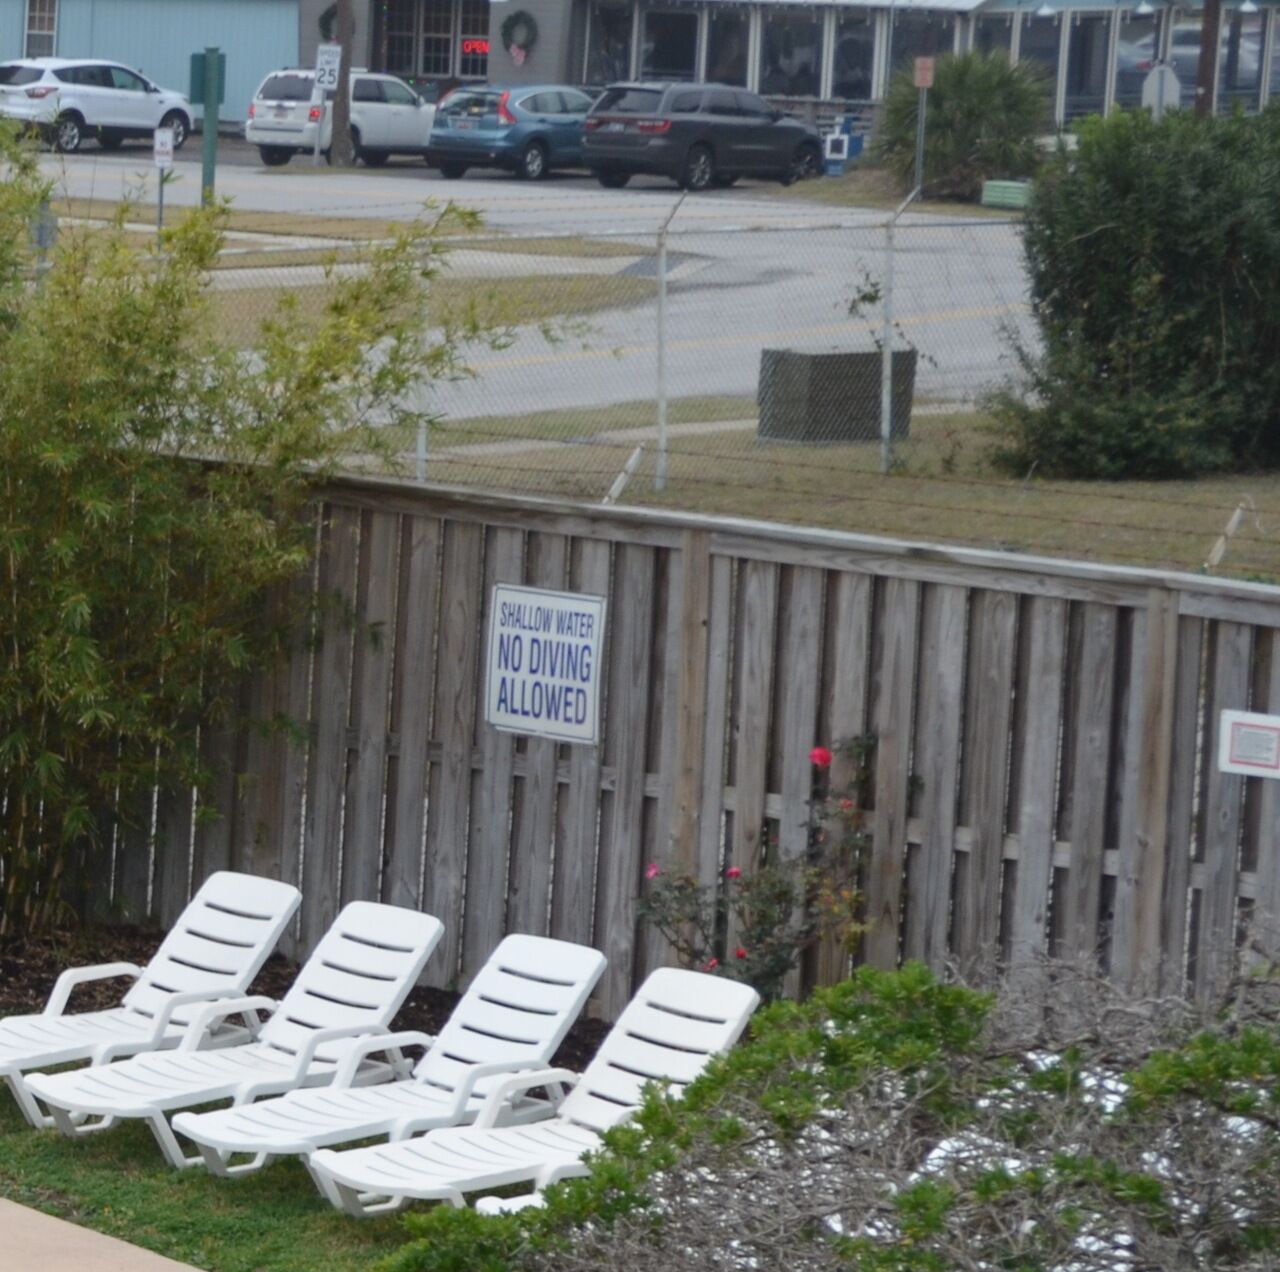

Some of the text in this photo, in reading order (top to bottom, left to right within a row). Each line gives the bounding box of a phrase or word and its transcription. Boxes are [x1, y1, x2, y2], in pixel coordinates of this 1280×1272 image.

[318, 68, 337, 84] 25
[500, 601, 594, 639] SHALLOW WATER
[498, 633, 592, 682] NO DIVING
[496, 676, 587, 725] ALLOWED
